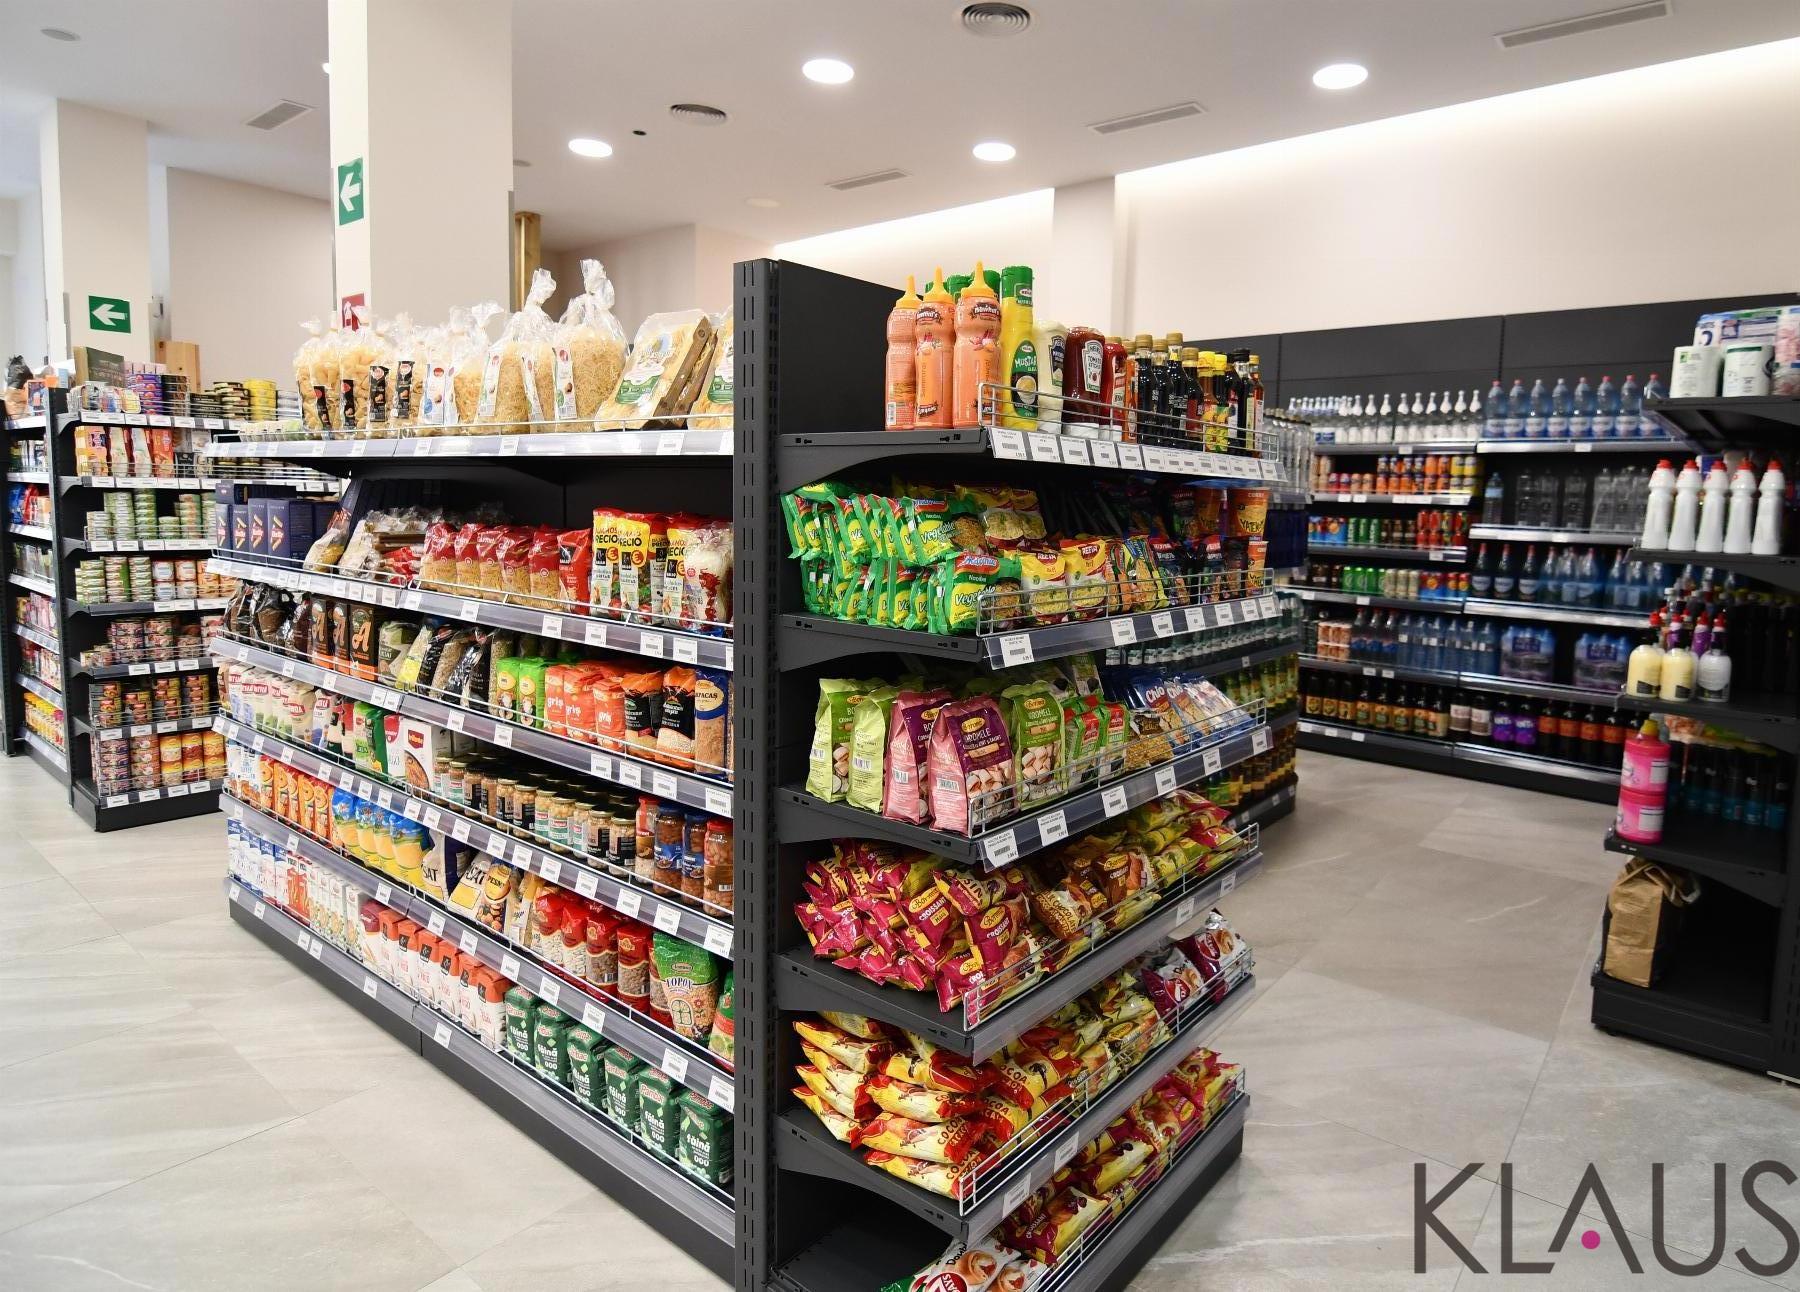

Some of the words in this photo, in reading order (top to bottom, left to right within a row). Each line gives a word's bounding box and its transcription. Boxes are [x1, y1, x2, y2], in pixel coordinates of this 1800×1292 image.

[1146, 685, 1165, 703] Chio
[918, 896, 947, 921] CROISSANT
[986, 916, 1010, 939] CROISSANT
[1000, 1063, 1028, 1084] OCOA
